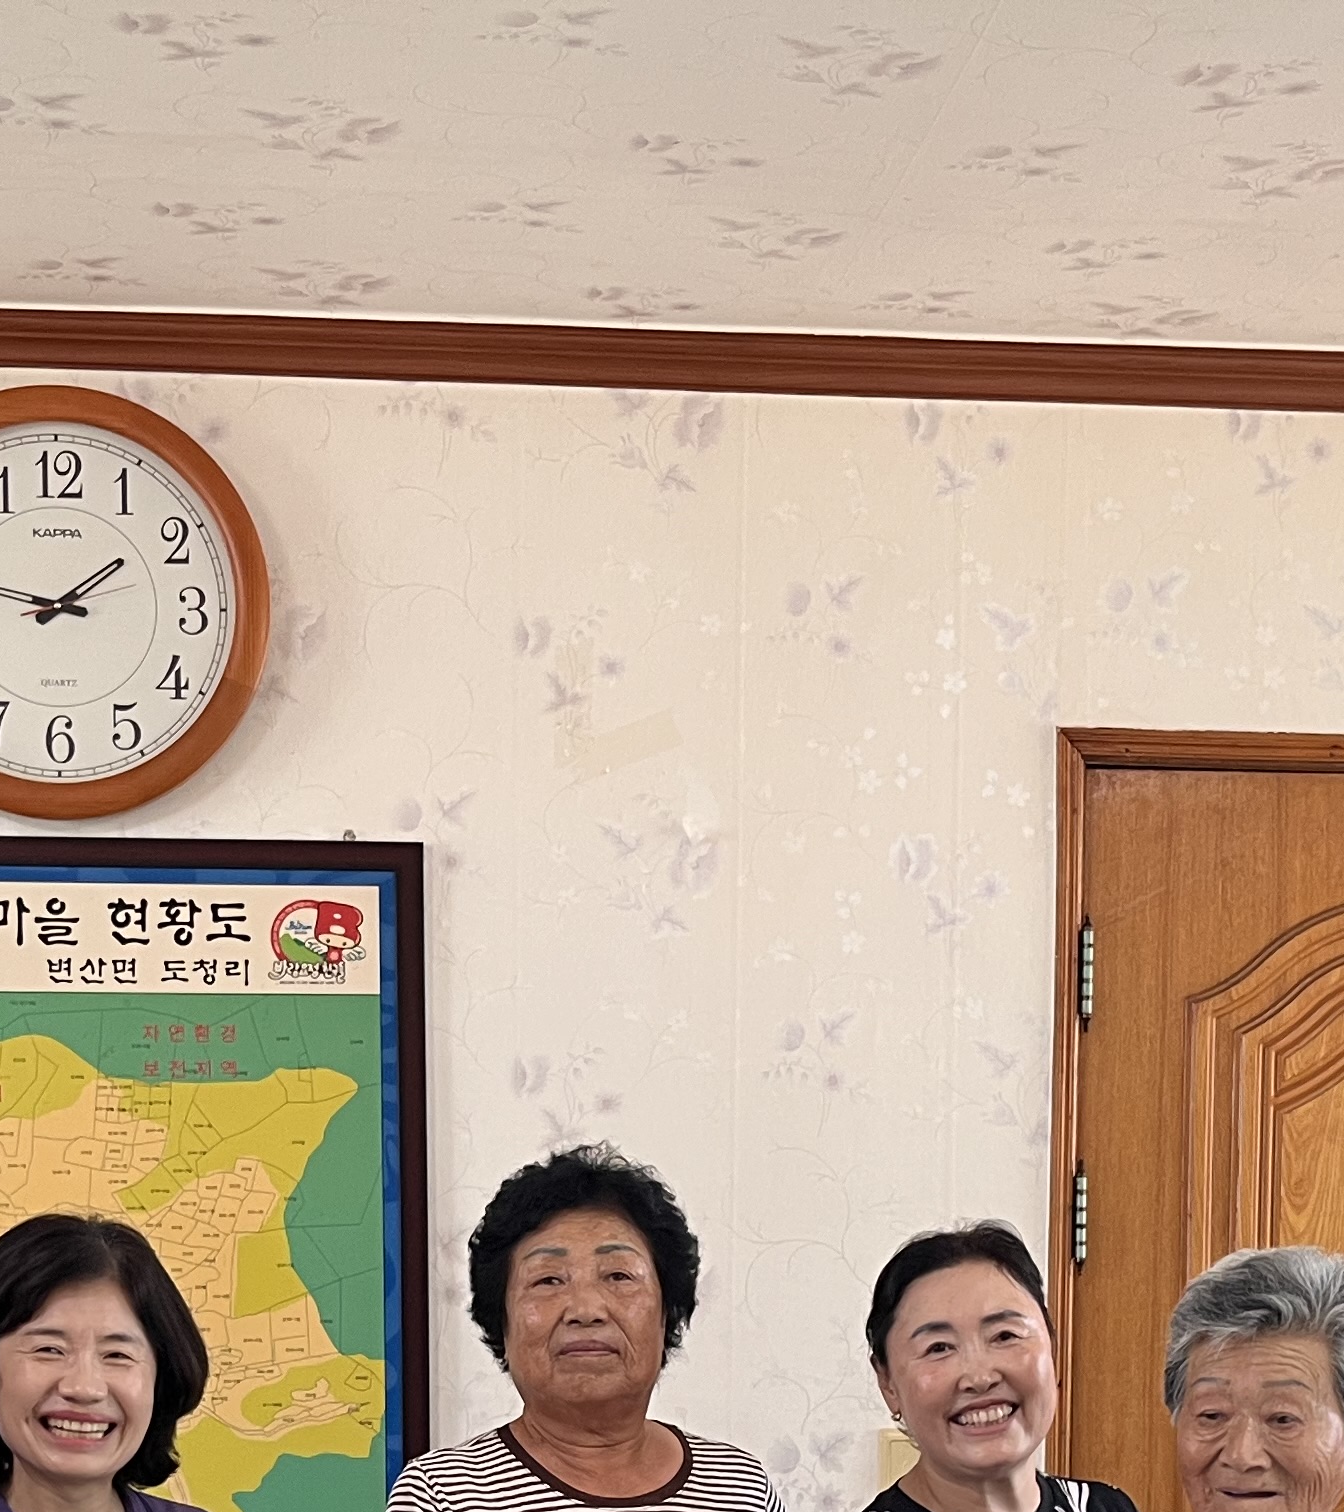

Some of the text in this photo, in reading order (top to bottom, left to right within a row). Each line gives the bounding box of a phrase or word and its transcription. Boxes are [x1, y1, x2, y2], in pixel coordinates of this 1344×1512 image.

[35, 450, 83, 499] 12
[113, 467, 134, 515] 1
[32, 528, 82, 539] KAPPA
[160, 516, 190, 564] 2
[178, 586, 208, 635] 3
[40, 678, 78, 687] QUARTZ
[156, 655, 189, 700] 4
[45, 715, 75, 763] 6
[111, 702, 142, 750] 5
[107, 897, 251, 946] 현황도
[46, 957, 250, 986] 변산면 도청리
